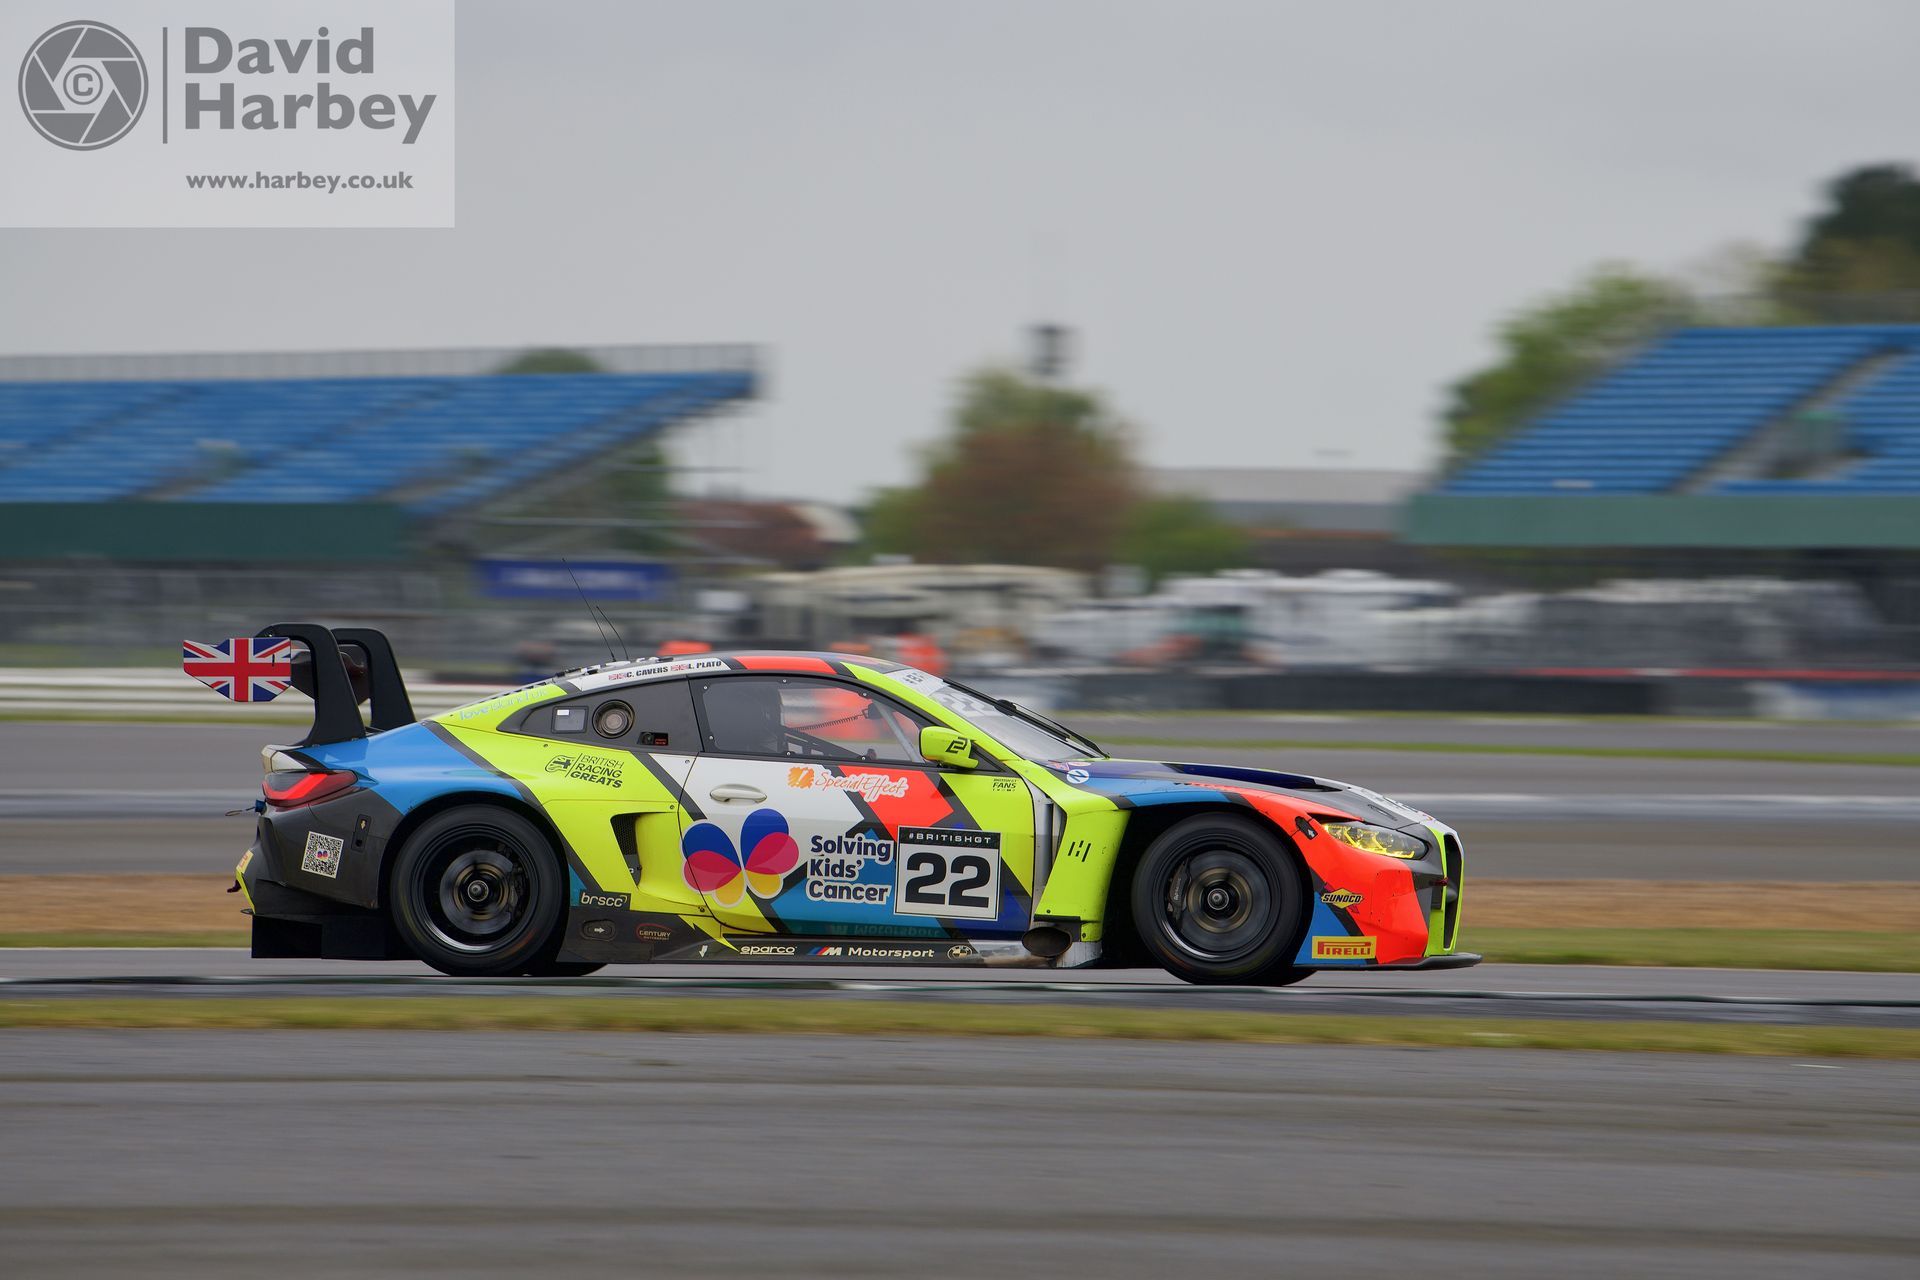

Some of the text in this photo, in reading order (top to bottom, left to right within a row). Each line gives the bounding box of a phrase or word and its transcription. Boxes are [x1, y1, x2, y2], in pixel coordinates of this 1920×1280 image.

[626, 666, 669, 679] C. CAVERS
[696, 661, 722, 670] PLATO
[580, 755, 625, 769] BRITISH
[575, 763, 623, 779] RACING
[570, 771, 623, 788] GREATS
[815, 771, 906, 800] SpecialEffect
[908, 832, 992, 845] #BRITISHGT
[810, 835, 892, 862] Solving
[905, 851, 992, 909] 22
[809, 880, 889, 902] Cancer
[580, 891, 624, 908] brscc
[1322, 894, 1362, 903] SUNOCO
[639, 930, 671, 938] CENTURY
[740, 945, 796, 956] sparco
[847, 946, 935, 959] Motorsport
[1317, 941, 1372, 955] PIRELLI
